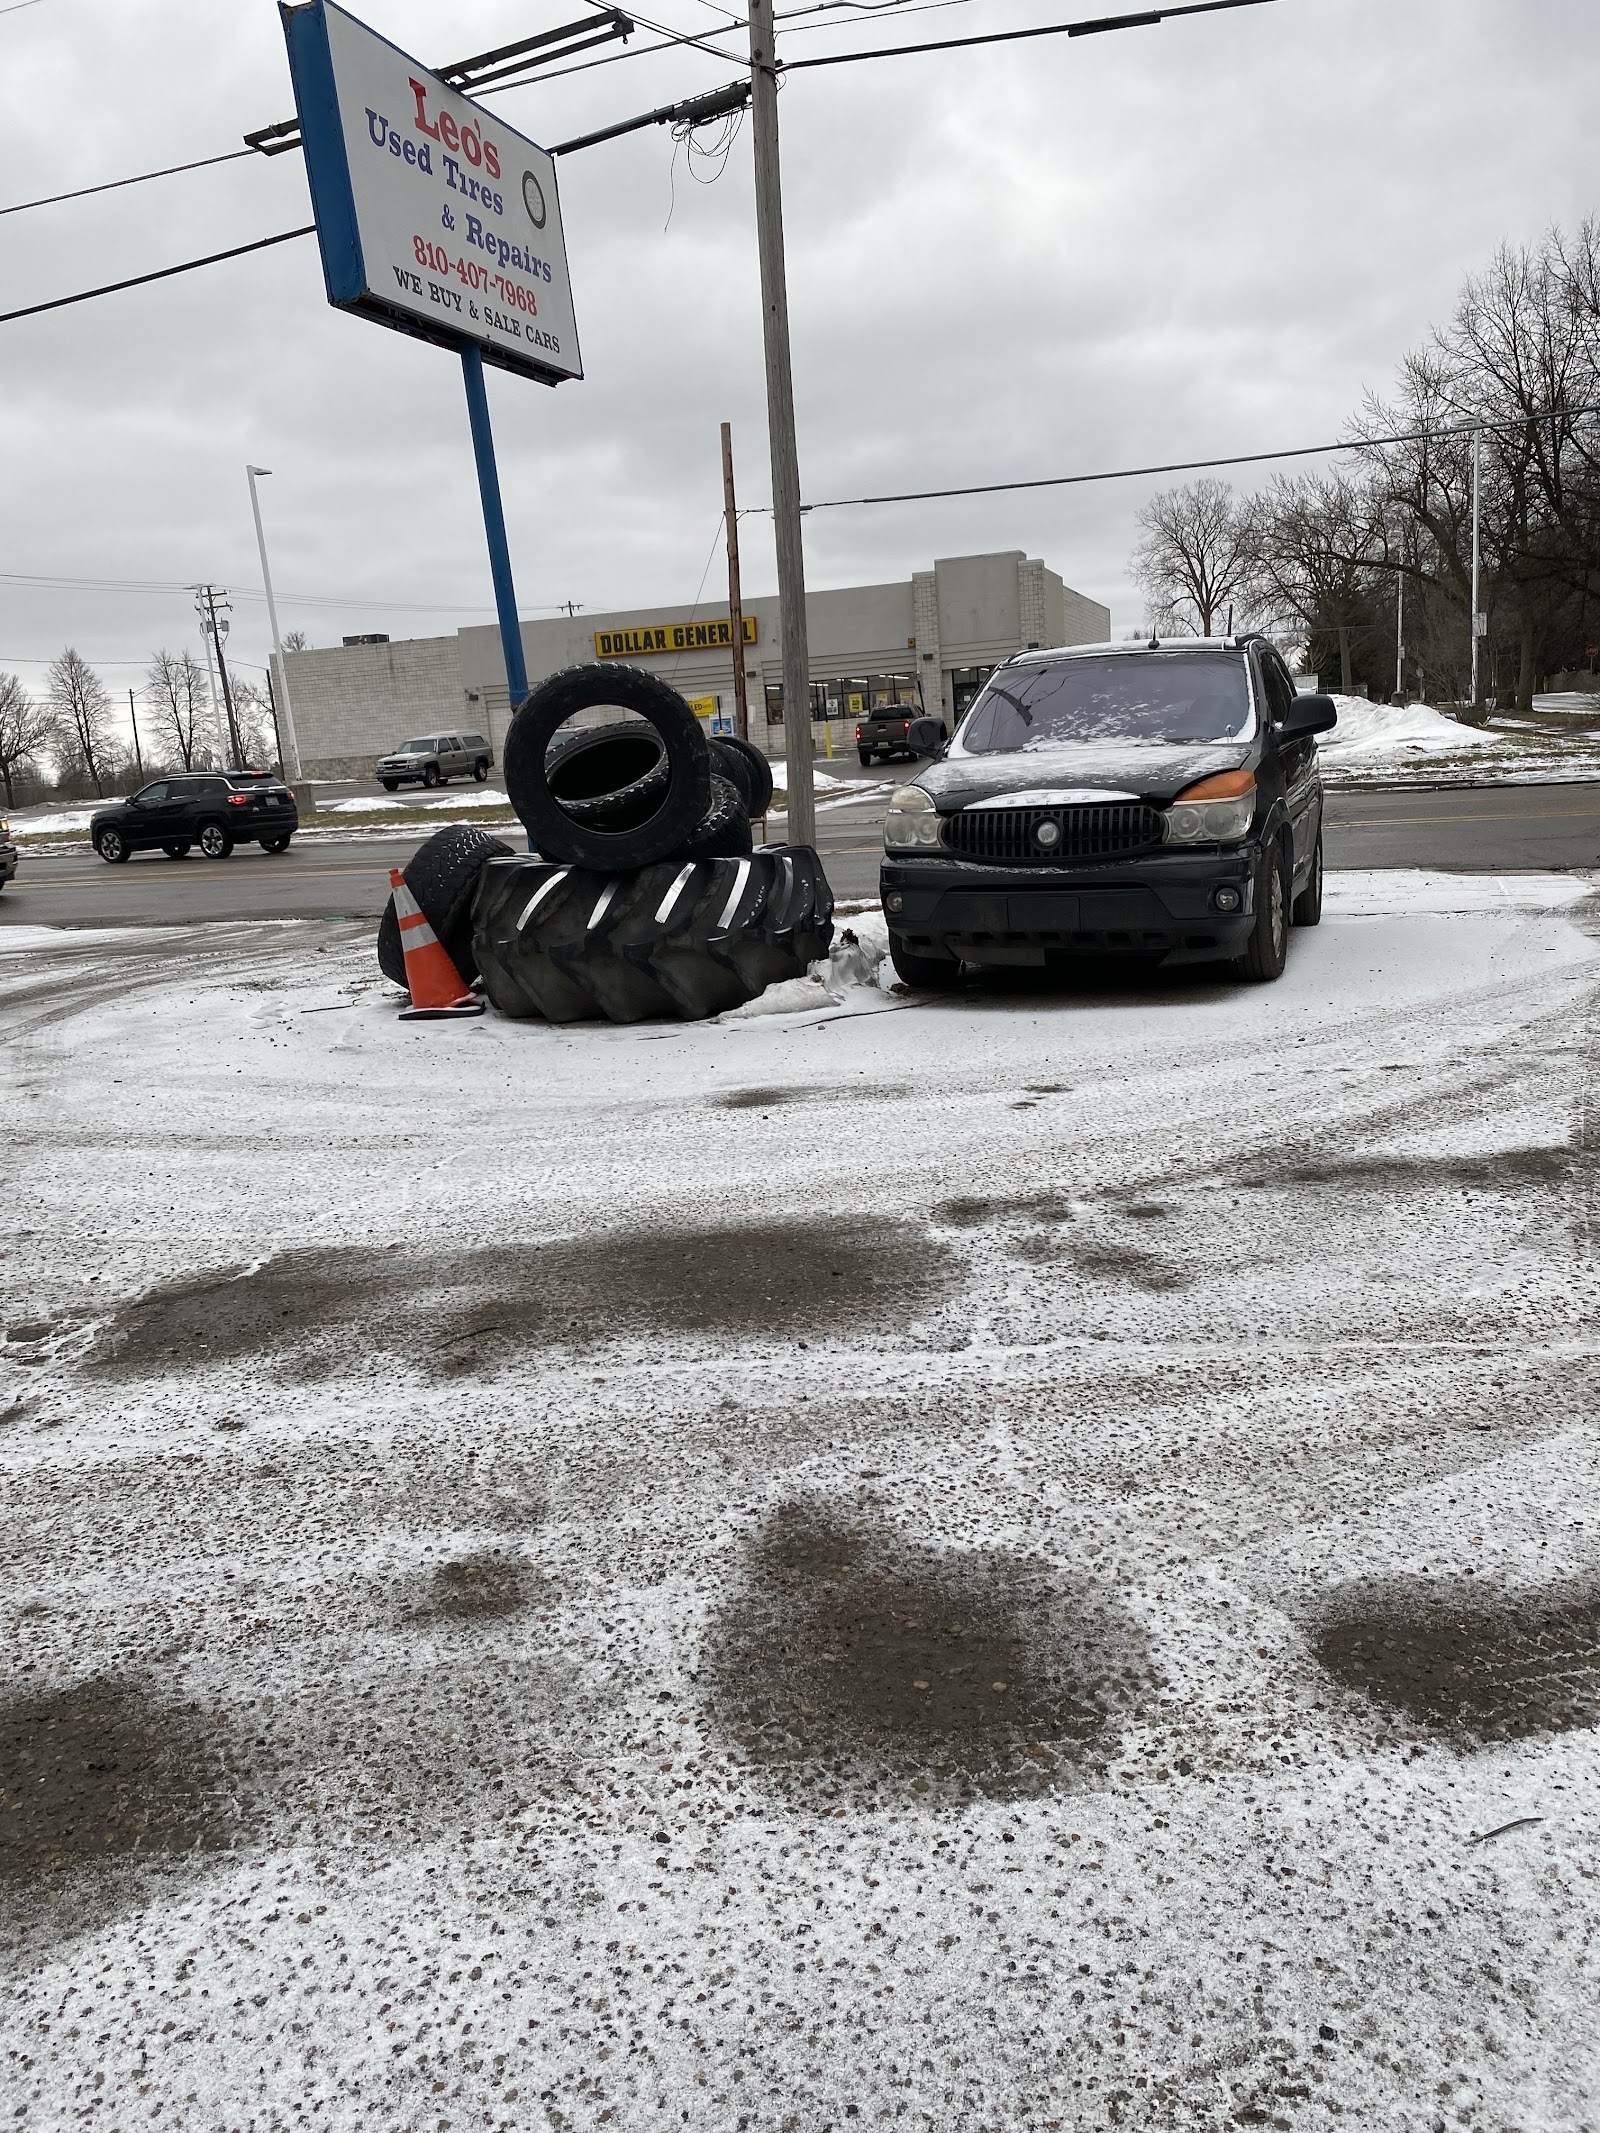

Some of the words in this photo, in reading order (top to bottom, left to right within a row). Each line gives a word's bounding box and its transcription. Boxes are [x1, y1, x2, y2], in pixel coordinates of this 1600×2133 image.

[365, 106, 433, 176] Used
[442, 154, 504, 216] Tires
[407, 76, 501, 180] Leo's
[413, 234, 538, 317] 810-407-7968
[441, 203, 455, 232] &
[465, 213, 552, 284] Repairs
[392, 265, 424, 296] WE
[428, 281, 462, 313] BUY
[469, 299, 479, 321] &
[484, 306, 522, 338] SALE
[525, 324, 560, 354] CARS
[600, 629, 667, 655] DOLLAR
[672, 621, 752, 648] GENERL
